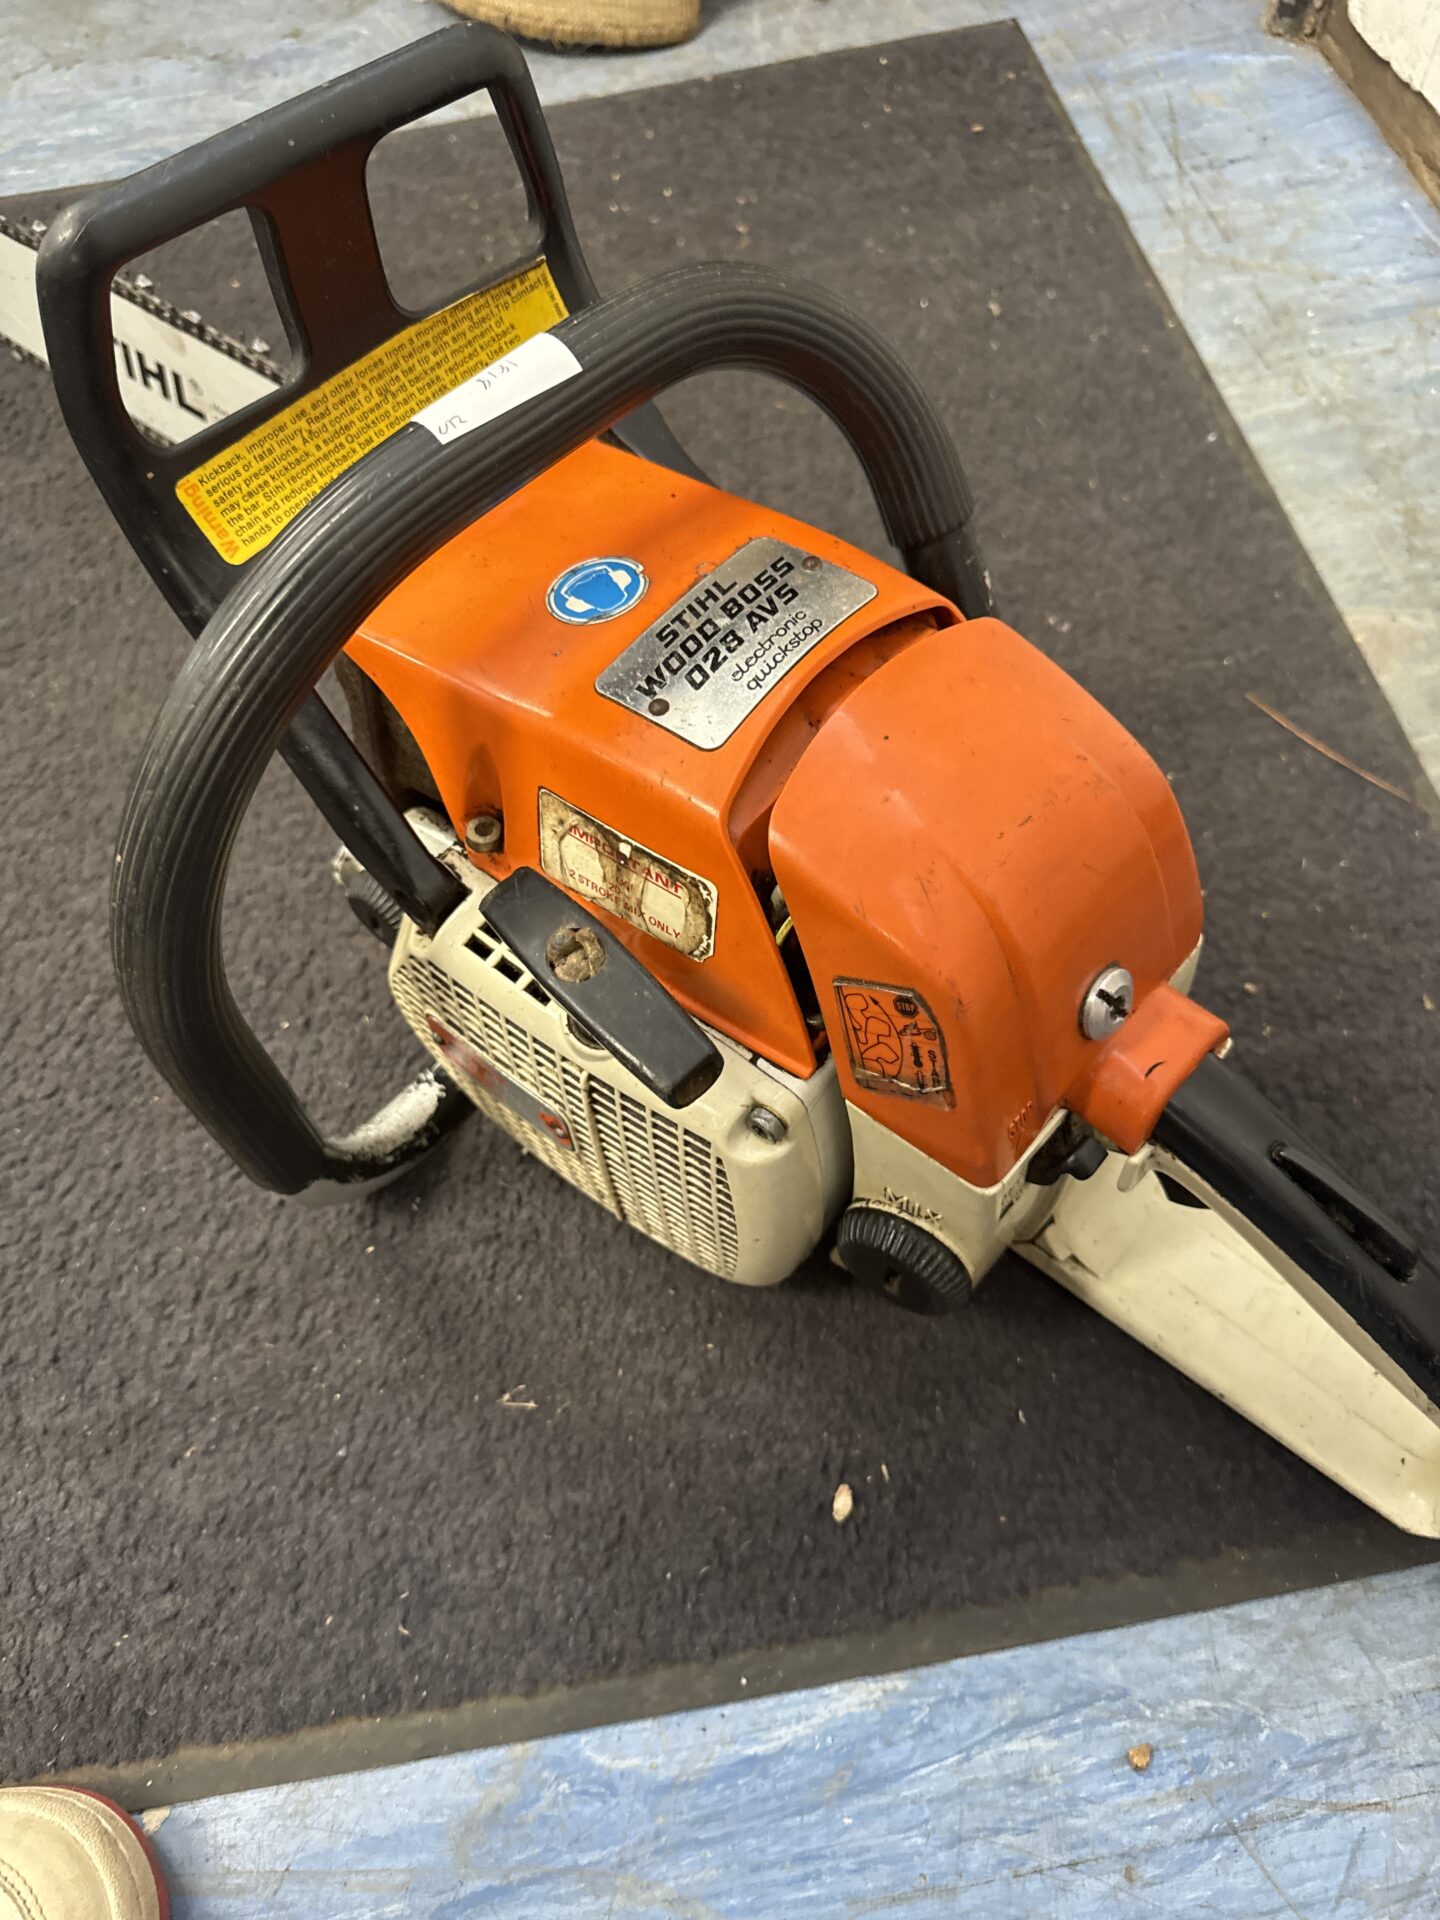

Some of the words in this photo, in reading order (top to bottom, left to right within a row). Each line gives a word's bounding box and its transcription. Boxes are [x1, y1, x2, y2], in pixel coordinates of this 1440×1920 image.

[113, 337, 208, 422] IHL
[197, 452, 246, 486] Kickback,
[245, 422, 289, 455] improper
[310, 393, 329, 411] and
[329, 377, 354, 397] other
[354, 357, 384, 380] forces
[385, 342, 406, 359] from
[415, 316, 447, 340] moving
[204, 468, 242, 497] serious
[241, 460, 253, 472] or
[252, 444, 276, 463] fatal
[305, 406, 331, 428] Read
[331, 382, 368, 410] owner's
[367, 358, 401, 385] manual
[401, 339, 431, 363] before
[431, 311, 473, 343] operating
[473, 299, 490, 315] and
[518, 271, 529, 285] all
[212, 483, 243, 508] safety
[300, 422, 328, 446] Avoid
[327, 398, 363, 427] contact
[363, 390, 374, 403] of
[374, 373, 401, 397] guide
[400, 362, 416, 377] bar
[416, 353, 430, 367] tip
[430, 339, 450, 357] with
[450, 329, 467, 344] any
[495, 299, 510, 313] Tip
[509, 277, 542, 304] contact
[219, 500, 241, 518] may
[241, 479, 270, 502] cause
[269, 448, 314, 482] kickback,
[314, 443, 321, 451] a
[322, 419, 356, 446] sudden
[356, 394, 390, 423] upward
[389, 383, 407, 399] and
[407, 354, 449, 387] backward
[449, 323, 494, 358] movement
[494, 315, 504, 328] of
[226, 511, 244, 527] the
[262, 481, 286, 502] Stihl
[286, 440, 345, 485] recommends
[344, 408, 391, 445] Quickstop
[391, 391, 416, 413] chain
[416, 373, 444, 395] brake,
[444, 348, 479, 376] reduced
[478, 322, 516, 352] kickback
[234, 514, 261, 537] chain
[261, 500, 280, 518] and
[279, 473, 318, 504] reduced
[317, 446, 357, 478] kickback
[357, 435, 374, 450] bar
[374, 427, 385, 439] to
[385, 405, 416, 431] reduce
[415, 395, 431, 410] the
[431, 382, 449, 399] risk
[448, 374, 459, 387] of
[486, 343, 504, 361] Use
[504, 333, 520, 349] two
[177, 480, 240, 559] Warning!
[241, 522, 271, 546] hands
[270, 514, 283, 525] to
[636, 615, 720, 699] WOOD
[726, 556, 795, 616] BOSS
[656, 577, 737, 648] STIHL
[685, 630, 744, 691] 028
[748, 583, 799, 633] AVS
[732, 609, 807, 681] electronic
[747, 616, 823, 691] quickstop
[569, 869, 578, 880] 2
[578, 873, 621, 905] STROKE
[624, 901, 645, 917] MIX
[649, 914, 681, 939] ONLY
[884, 1187, 943, 1230] MIX
